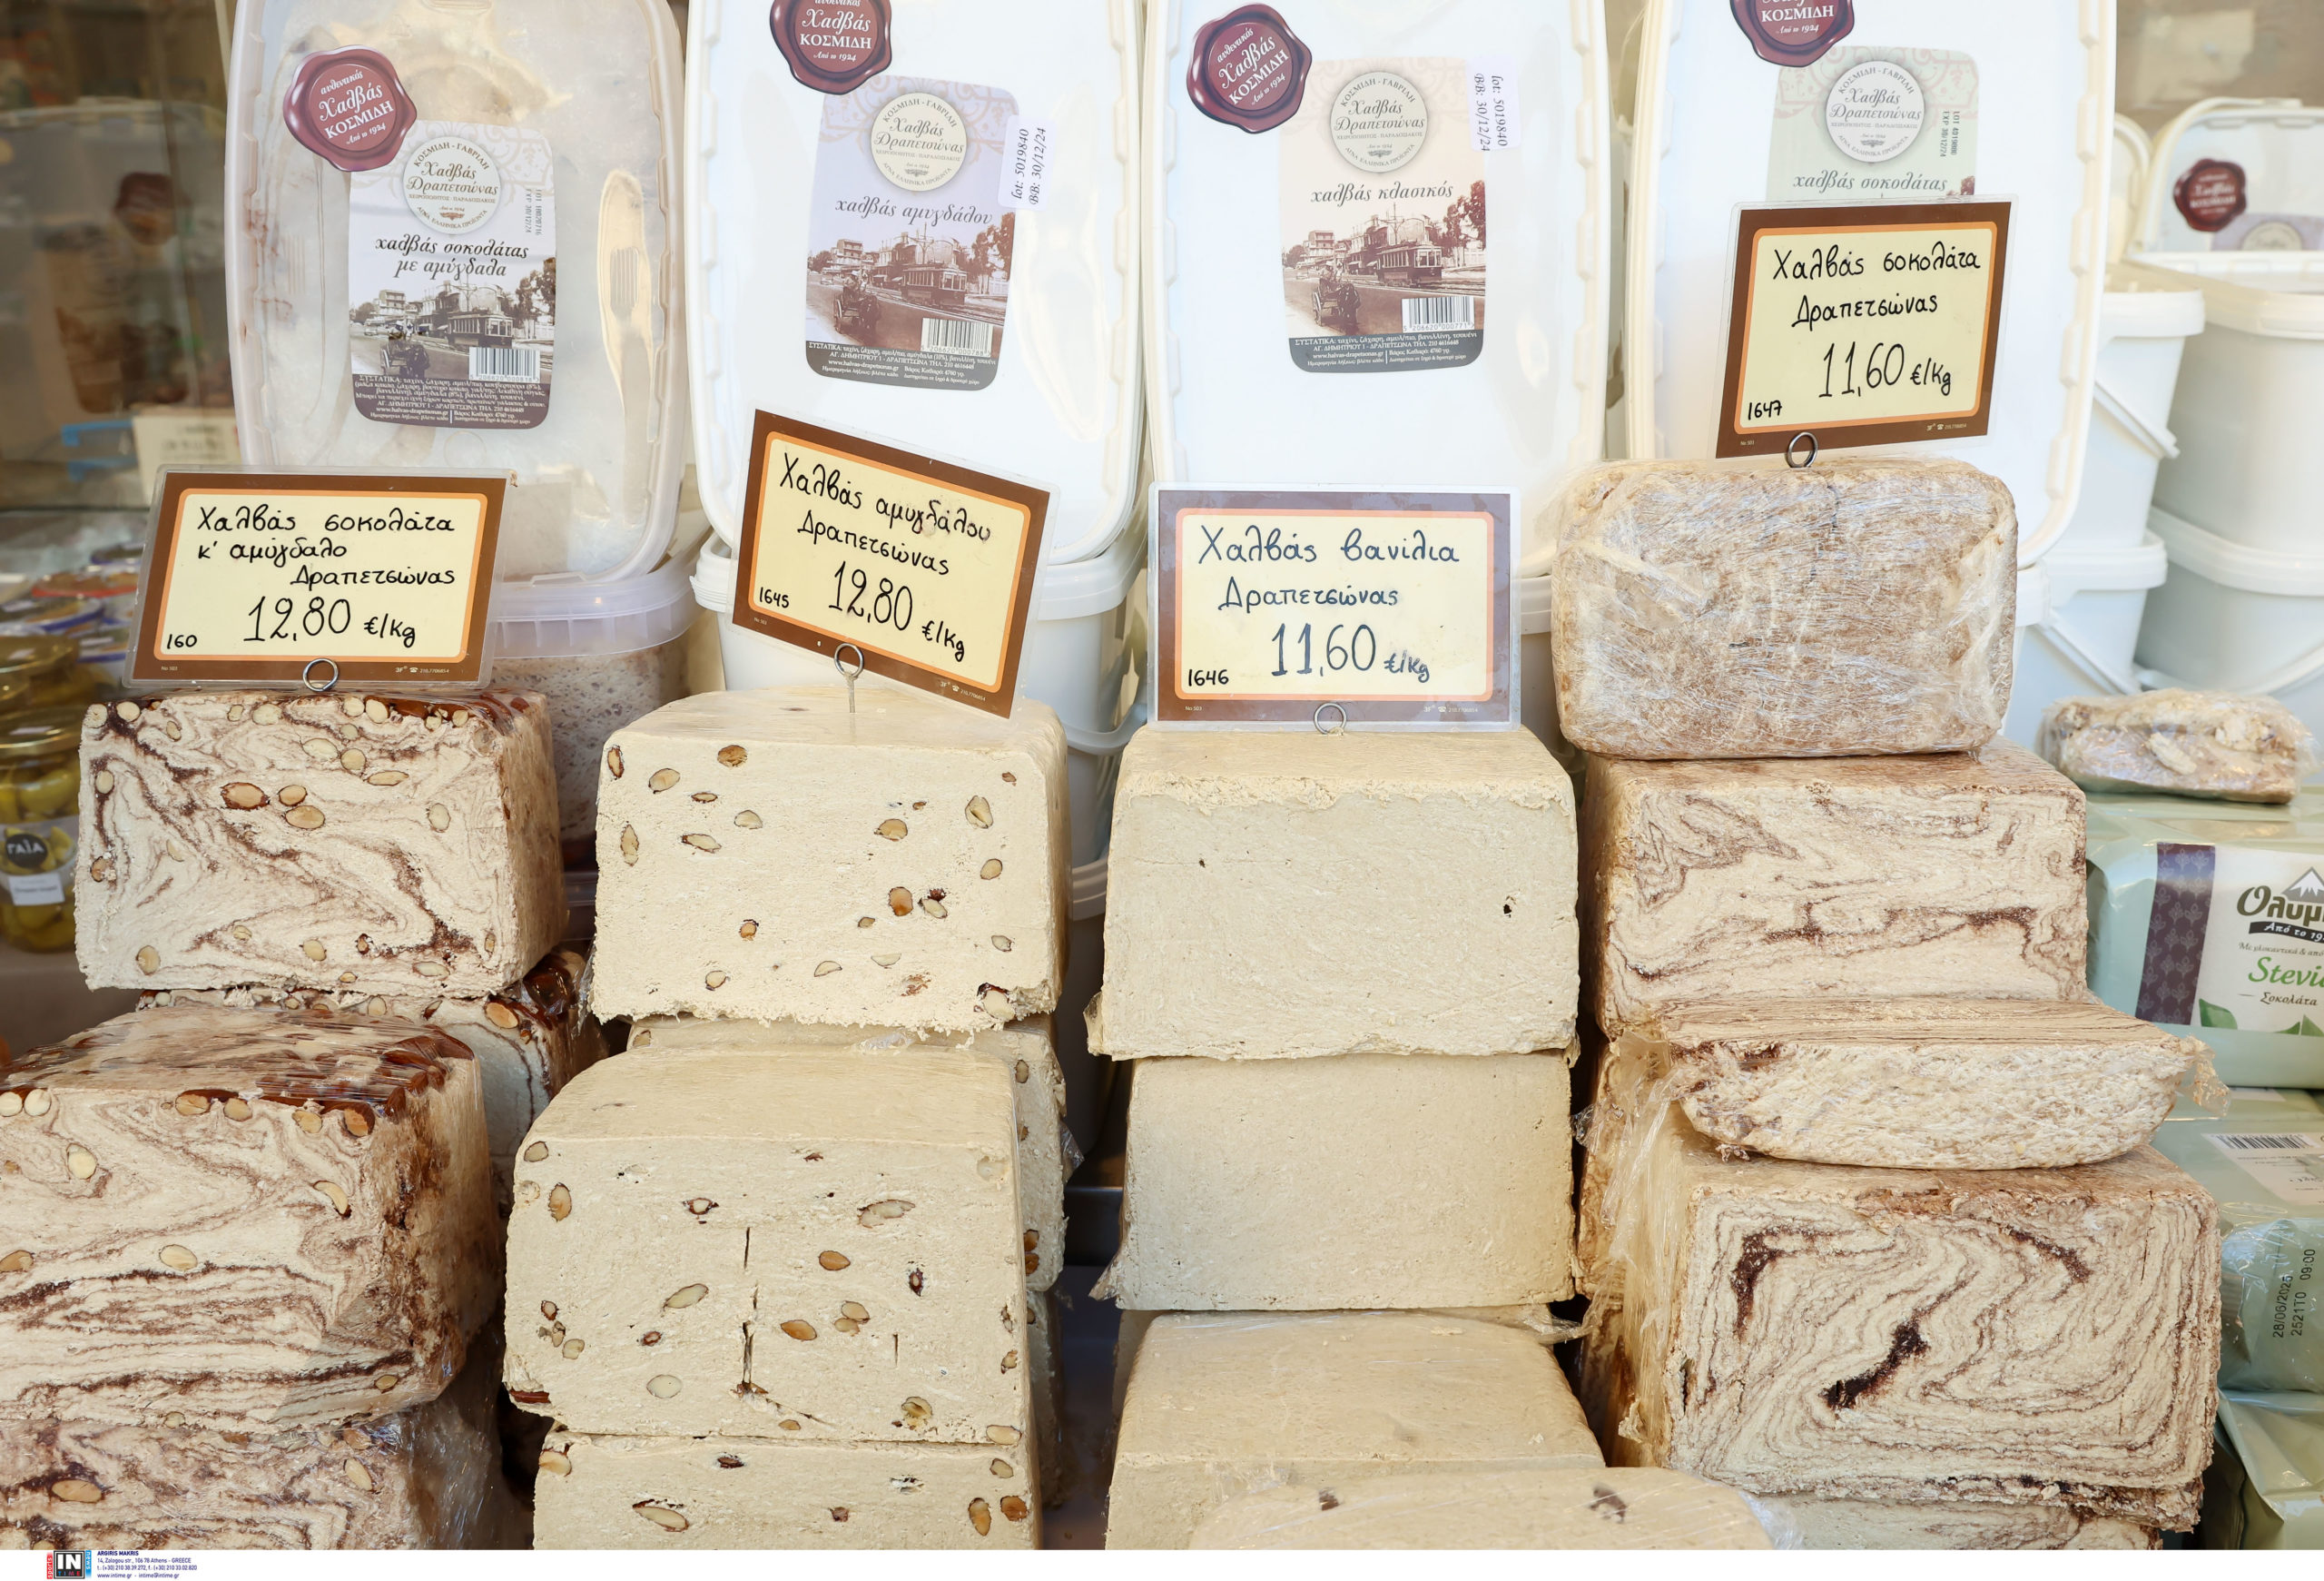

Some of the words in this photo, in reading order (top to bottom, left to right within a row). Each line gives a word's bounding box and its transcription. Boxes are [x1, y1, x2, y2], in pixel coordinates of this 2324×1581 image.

[802, 9, 871, 35] Χαλβάς
[1762, 5, 1834, 22] ΚΟΣΜΙΔΗ
[800, 33, 872, 49] ΚΟΣΜΙΔΗ
[1802, 25, 1819, 33] 1924
[839, 54, 856, 62] 1924
[1217, 27, 1253, 63] αυθεντικός
[1219, 36, 1275, 88] Χαλβάς
[321, 69, 363, 94] αυθεντικός
[1229, 49, 1289, 105] ΚΟΣΜΙΔΗ
[1271, 73, 1285, 88] 1924
[1474, 73, 1485, 95] BB:
[319, 82, 383, 121] Χαλβάς
[1341, 78, 1376, 107] ΚΟΣΜΙΔΗ
[1845, 88, 1900, 108] Χαλβάς
[324, 101, 394, 139] ΚΟΣΜΙΔΗ
[883, 98, 920, 122] ΚΟΣΜΙΔΗ
[1348, 99, 1403, 119] Χαλβάς
[1493, 98, 1508, 146] 5019840
[369, 123, 386, 135] 1924
[890, 118, 944, 138] Χαλβάς
[1475, 100, 1491, 151] 30/12/24
[414, 142, 450, 167] ΚΟΣΜΙΔΗ
[1015, 129, 1029, 177] 5019840
[1032, 128, 1047, 179] 30/12/24
[421, 161, 476, 181] Χαλβάς
[1793, 169, 1855, 194] χαλβάς
[1861, 171, 1947, 191] σοκολάτας
[1029, 183, 1040, 205] BB:
[1310, 183, 1372, 207] χαλβάς
[1378, 181, 1453, 200] κλασικός
[835, 196, 897, 219] χαλβάς
[902, 204, 993, 226] αμυγδάλου
[375, 233, 438, 256] χαλβάς
[443, 238, 529, 259] σοκολάτας
[394, 259, 418, 278] με
[423, 257, 507, 280] αμύγδαλα
[1773, 244, 1864, 279] Χαλβάς
[1883, 241, 1980, 272] σοκολάτα
[1792, 293, 1938, 331] Δραπετσώνας
[1818, 342, 1904, 397] 11,60
[1747, 400, 1782, 420] 1647
[779, 451, 862, 509] Χαλβάς
[875, 499, 991, 542] αμυγδάλου
[197, 503, 297, 532] Χαλβάς
[324, 508, 455, 532] σοκολάτα
[230, 537, 348, 568] αμύγδαλο
[797, 509, 949, 575] Δραπετσώνας
[1198, 525, 1316, 564] Χαλβάς
[1341, 528, 1459, 563] βανίλια
[290, 564, 455, 591] Δραπετσώνας
[759, 587, 790, 608] 1645
[828, 560, 913, 631] 12,80
[1218, 576, 1398, 613] Δραπετσώνας
[243, 596, 351, 642] 12,80
[166, 633, 198, 650] 160
[1271, 623, 1377, 677] 11,60
[1187, 669, 1229, 687] 1646
[2237, 885, 2324, 927] Ολυμ
[2264, 922, 2290, 933] Από
[2294, 929, 2307, 937] το
[2311, 931, 2324, 942] 19
[2239, 942, 2252, 951] Με
[2260, 992, 2318, 1006] Σοκολάτα
[2299, 1249, 2316, 1280] 09:00
